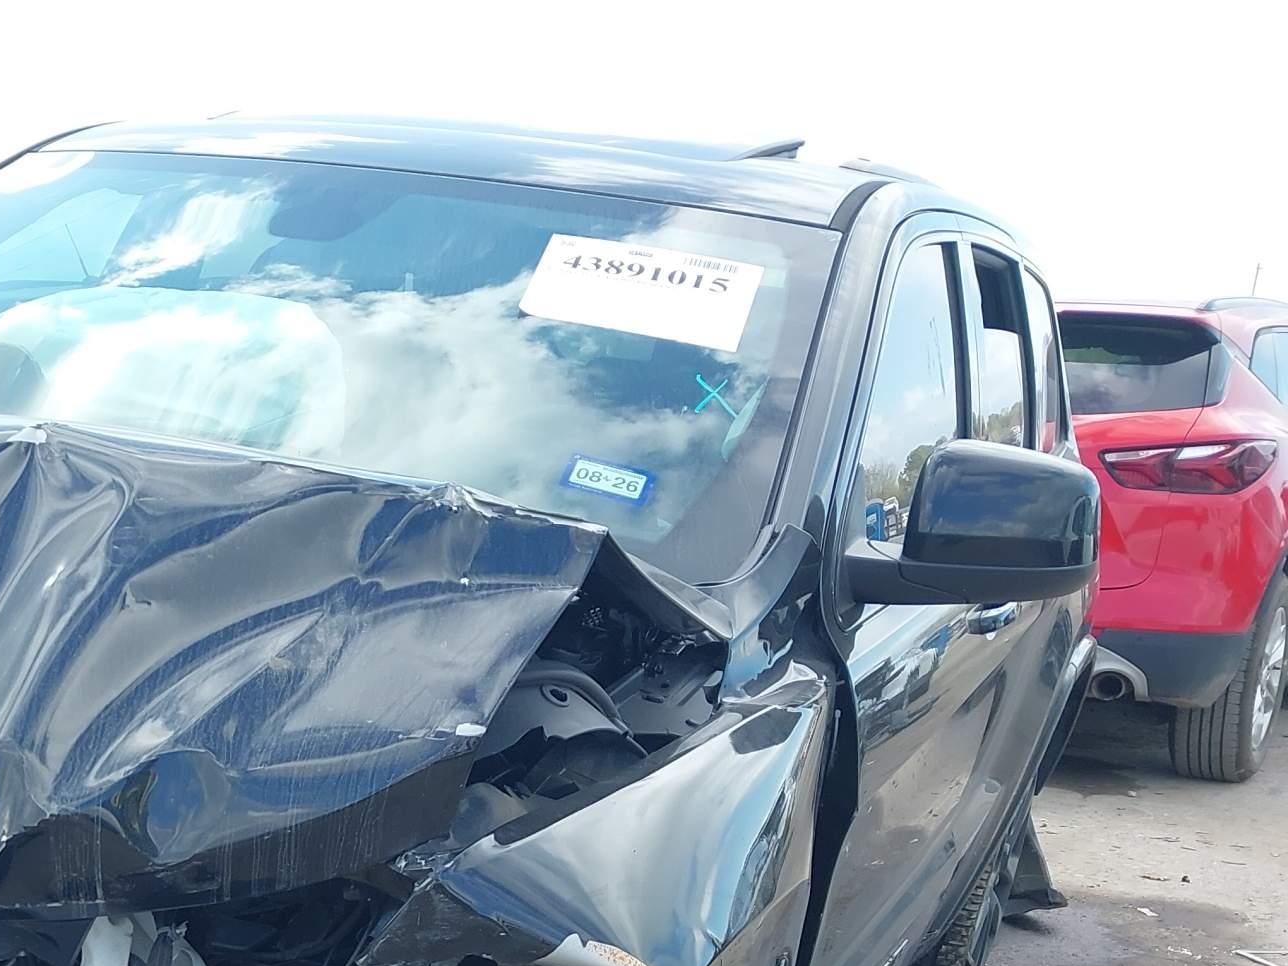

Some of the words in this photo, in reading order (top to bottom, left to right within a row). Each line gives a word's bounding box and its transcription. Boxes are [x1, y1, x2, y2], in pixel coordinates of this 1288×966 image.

[563, 255, 730, 293] 43891015
[575, 467, 603, 483] 08
[611, 476, 640, 493] 26
